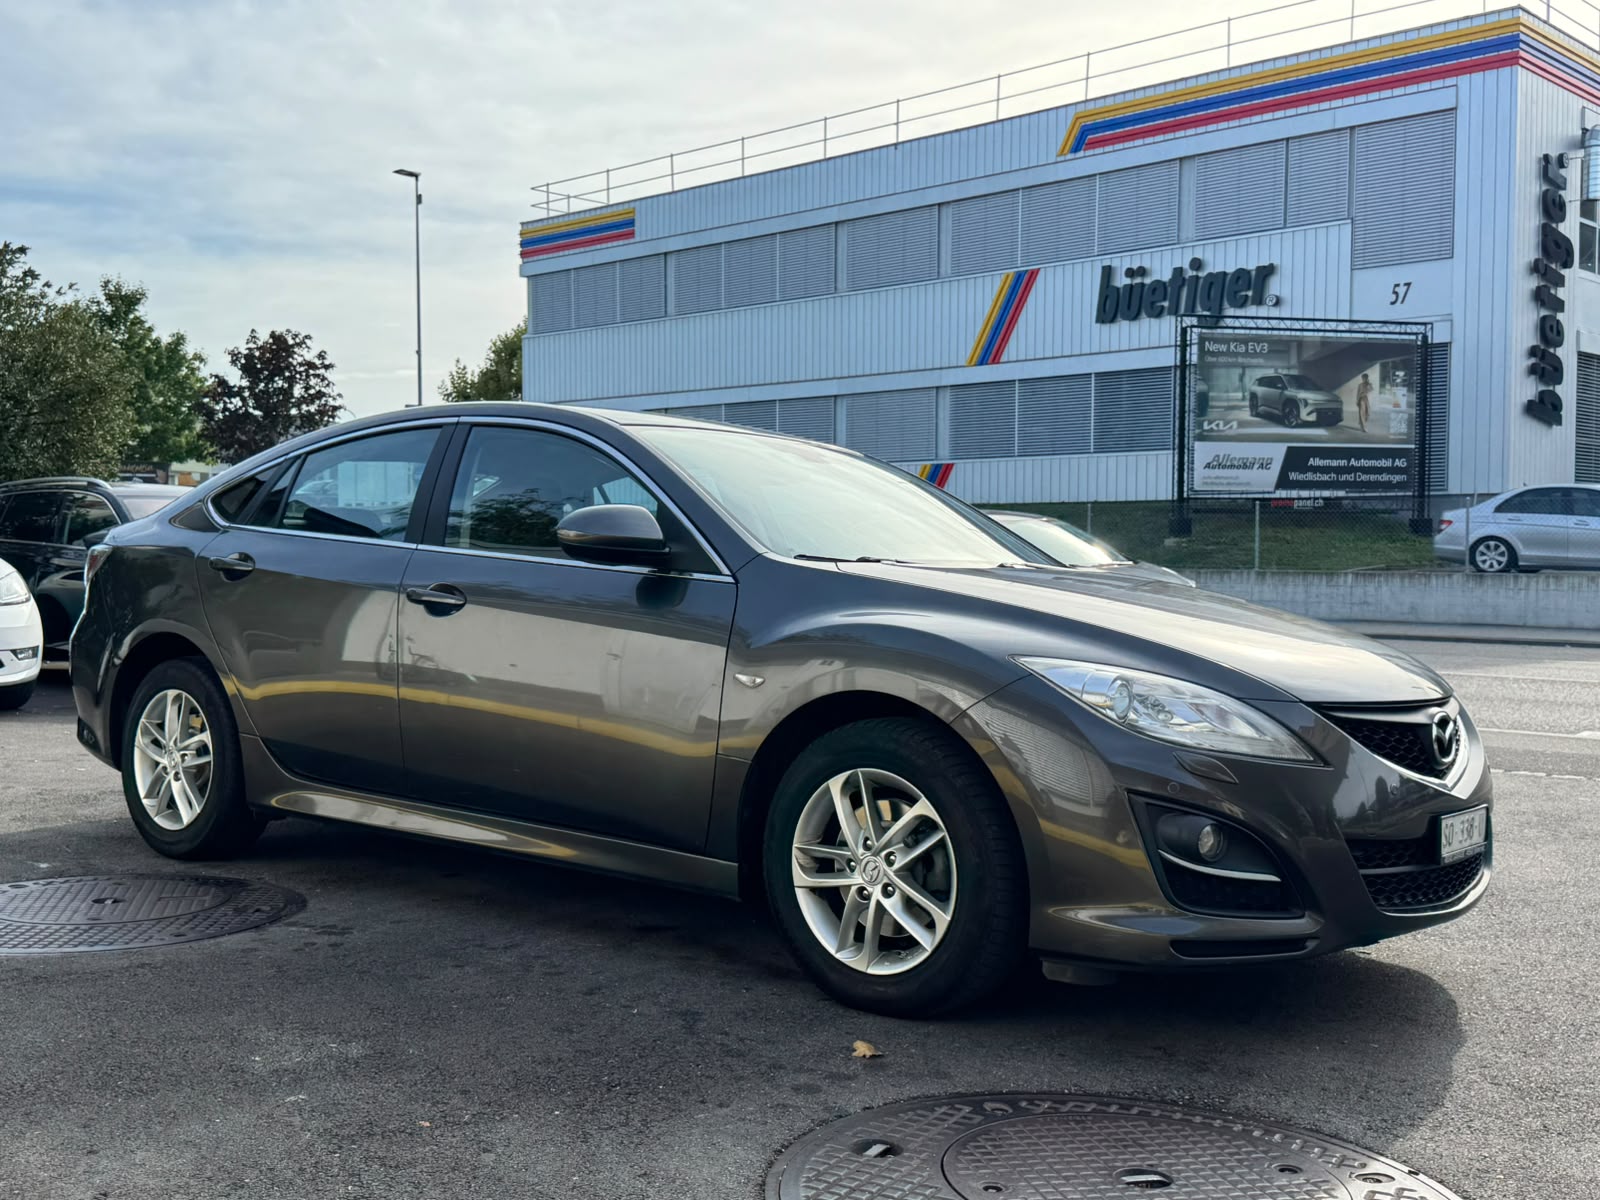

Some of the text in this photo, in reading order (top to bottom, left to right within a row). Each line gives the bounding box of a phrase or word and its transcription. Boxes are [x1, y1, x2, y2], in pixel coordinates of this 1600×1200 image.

[1389, 282, 1412, 305] 57
[1204, 341, 1269, 354] New Kia EV3
[1211, 453, 1274, 465] Allemann
[1307, 457, 1408, 468] Allemann Automobil AG
[1203, 462, 1273, 471] Automobil AG
[1288, 471, 1408, 484] Wiedlisbach und Derendingen
